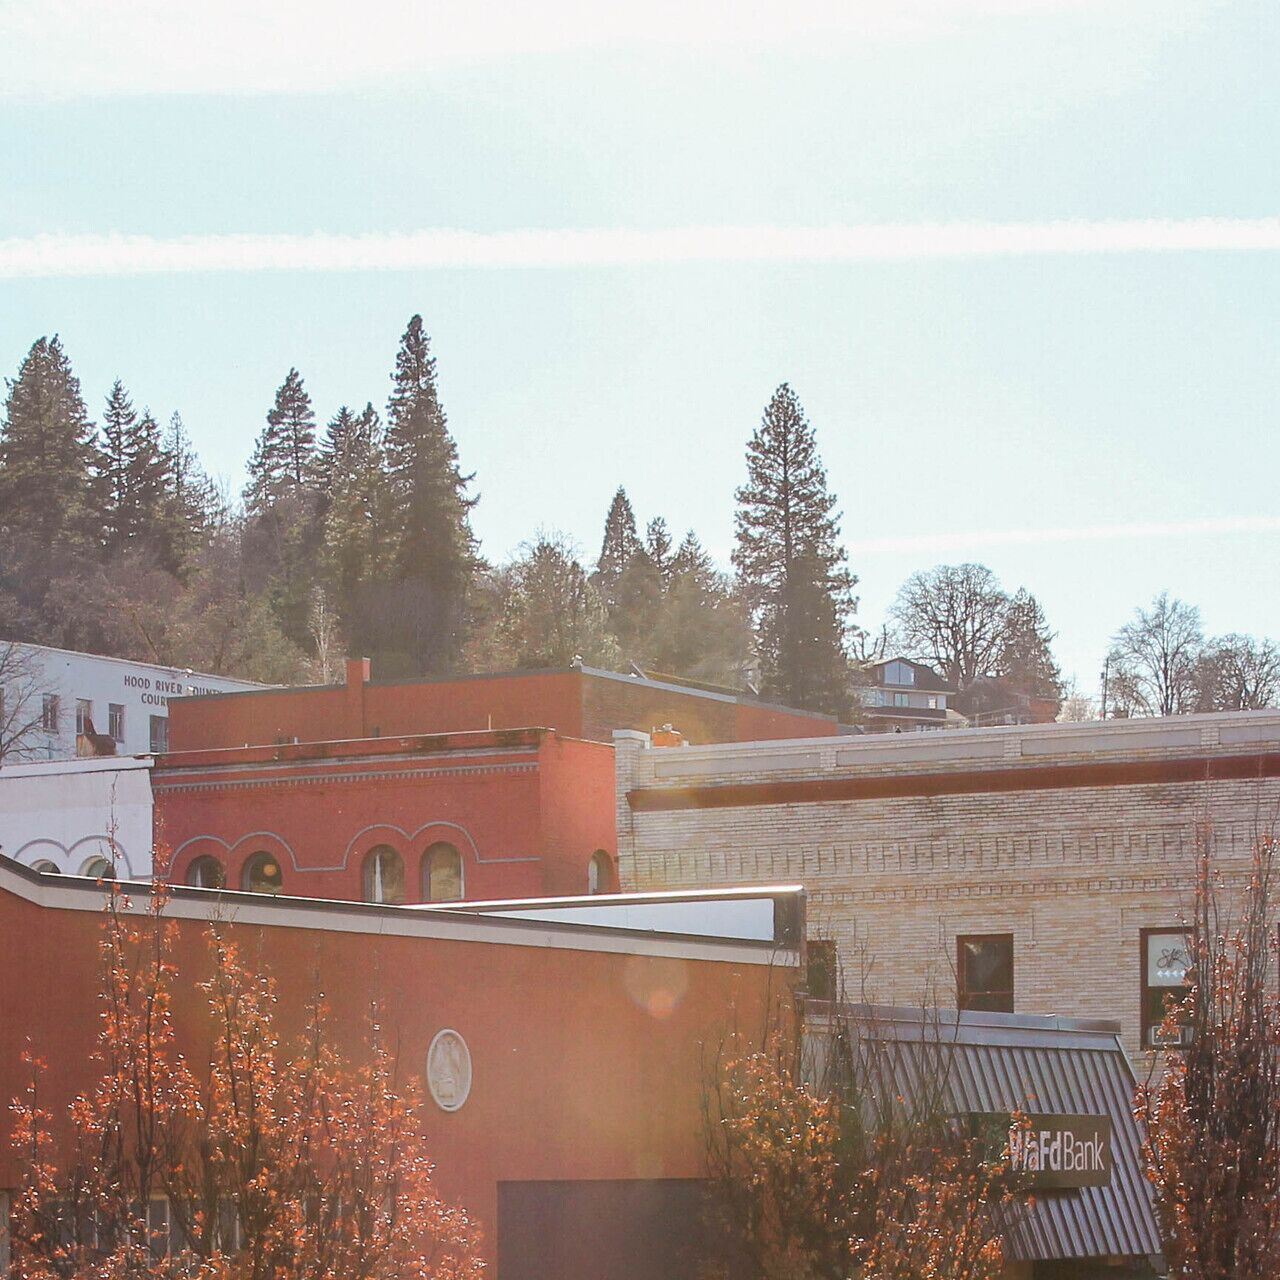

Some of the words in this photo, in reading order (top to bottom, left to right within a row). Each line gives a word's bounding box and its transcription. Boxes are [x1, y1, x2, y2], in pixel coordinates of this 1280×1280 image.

[124, 675, 151, 690] HOOD
[155, 680, 183, 695] RIVER
[141, 693, 166, 707] COUR
[1063, 1131, 1105, 1171] Bank
